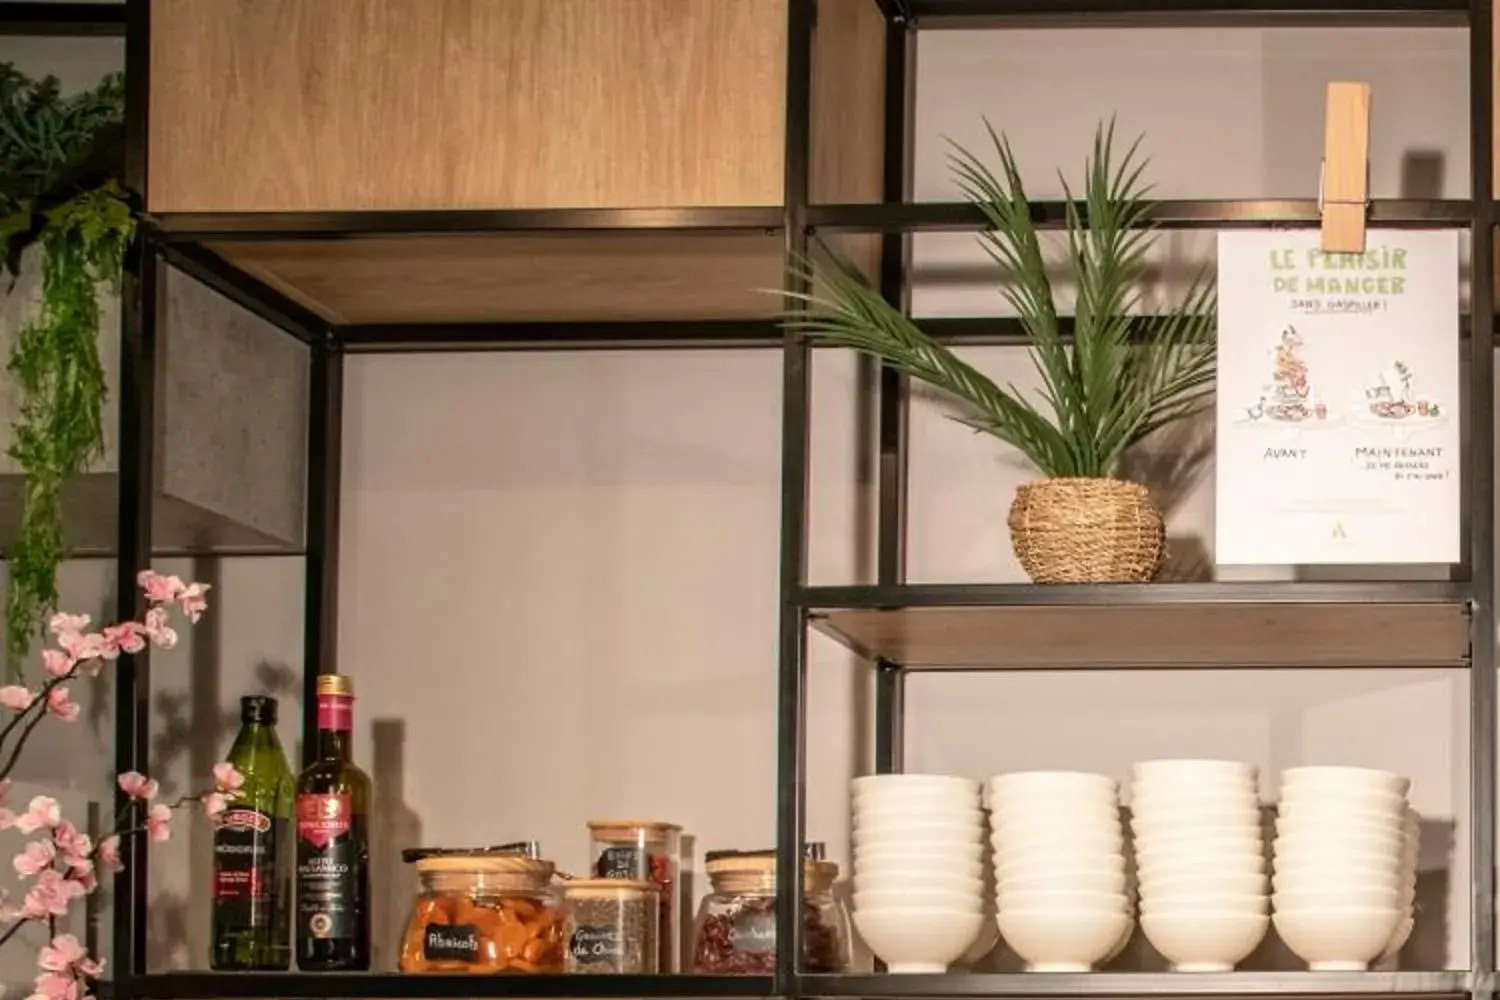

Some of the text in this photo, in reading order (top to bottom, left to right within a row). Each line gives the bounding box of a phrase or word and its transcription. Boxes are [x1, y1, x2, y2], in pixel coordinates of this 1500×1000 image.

[1270, 249, 1295, 270] LE
[1274, 277, 1406, 293] DE MANGER
[1290, 300, 1320, 309] SANS
[1263, 447, 1307, 460] AVANT
[1355, 447, 1443, 458] MAINTENANT
